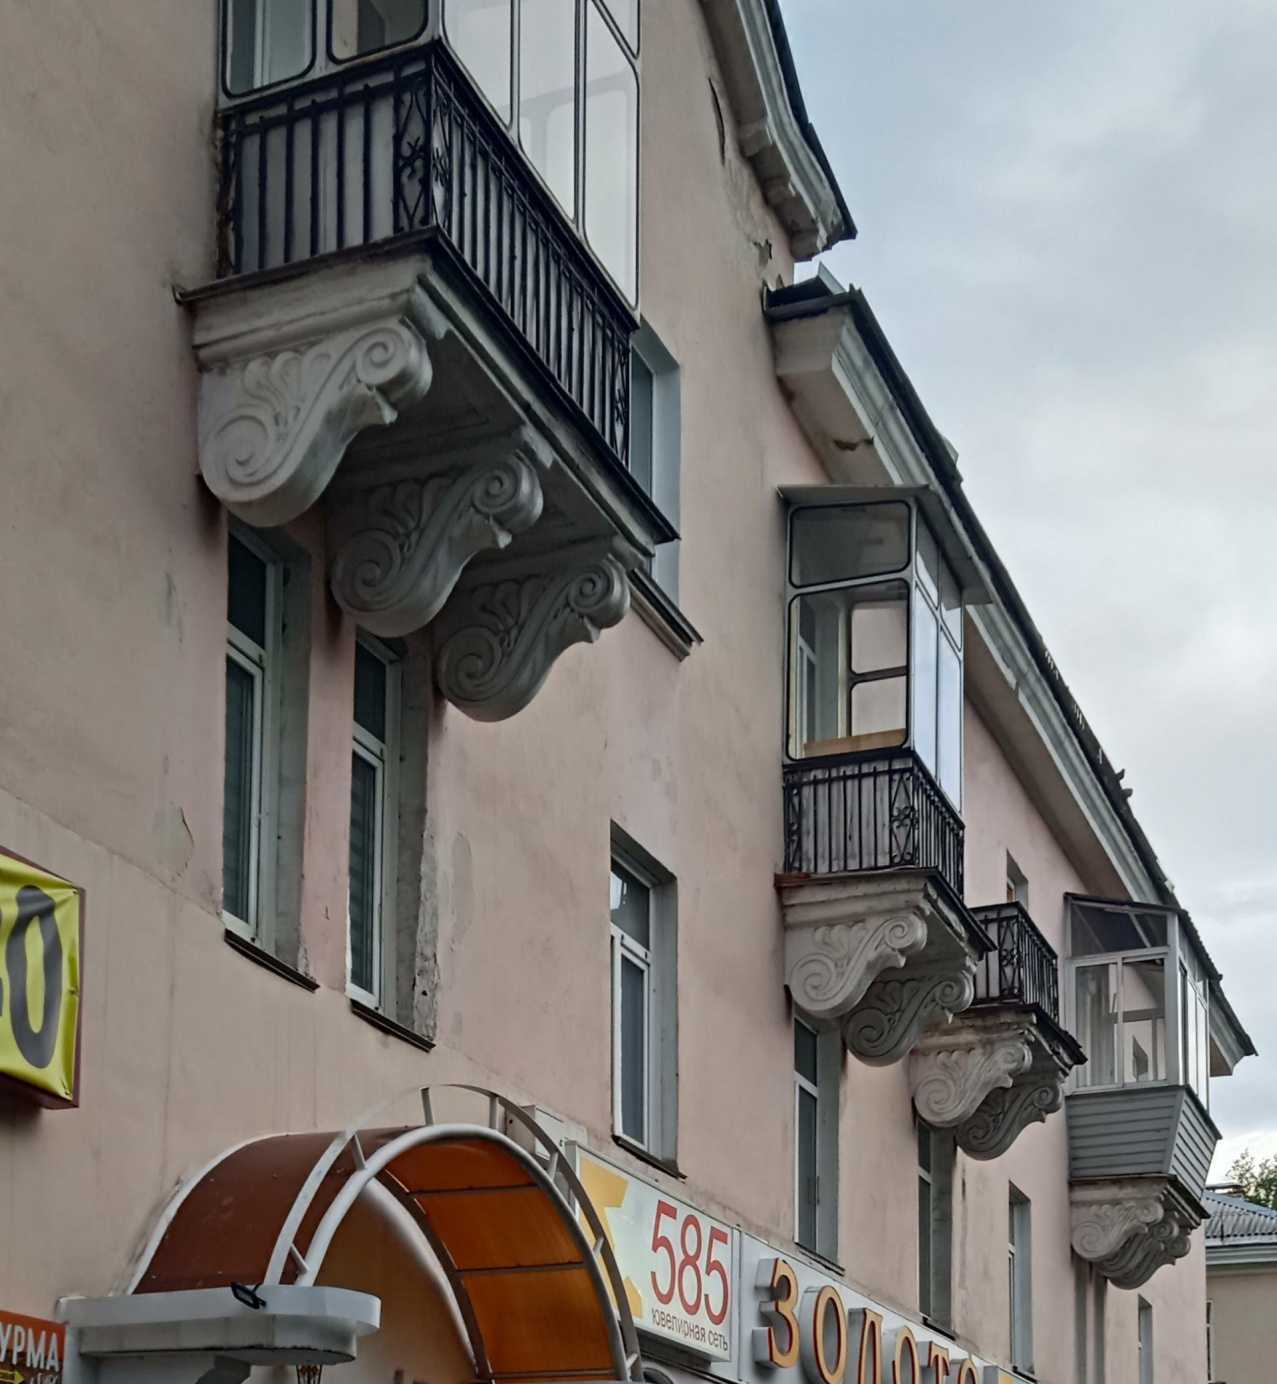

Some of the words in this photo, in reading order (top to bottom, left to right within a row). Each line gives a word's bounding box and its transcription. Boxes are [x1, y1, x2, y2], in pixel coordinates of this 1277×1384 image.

[650, 1199, 729, 1325] 585
[652, 1306, 706, 1343] ювелирная
[707, 1329, 729, 1351] сеть
